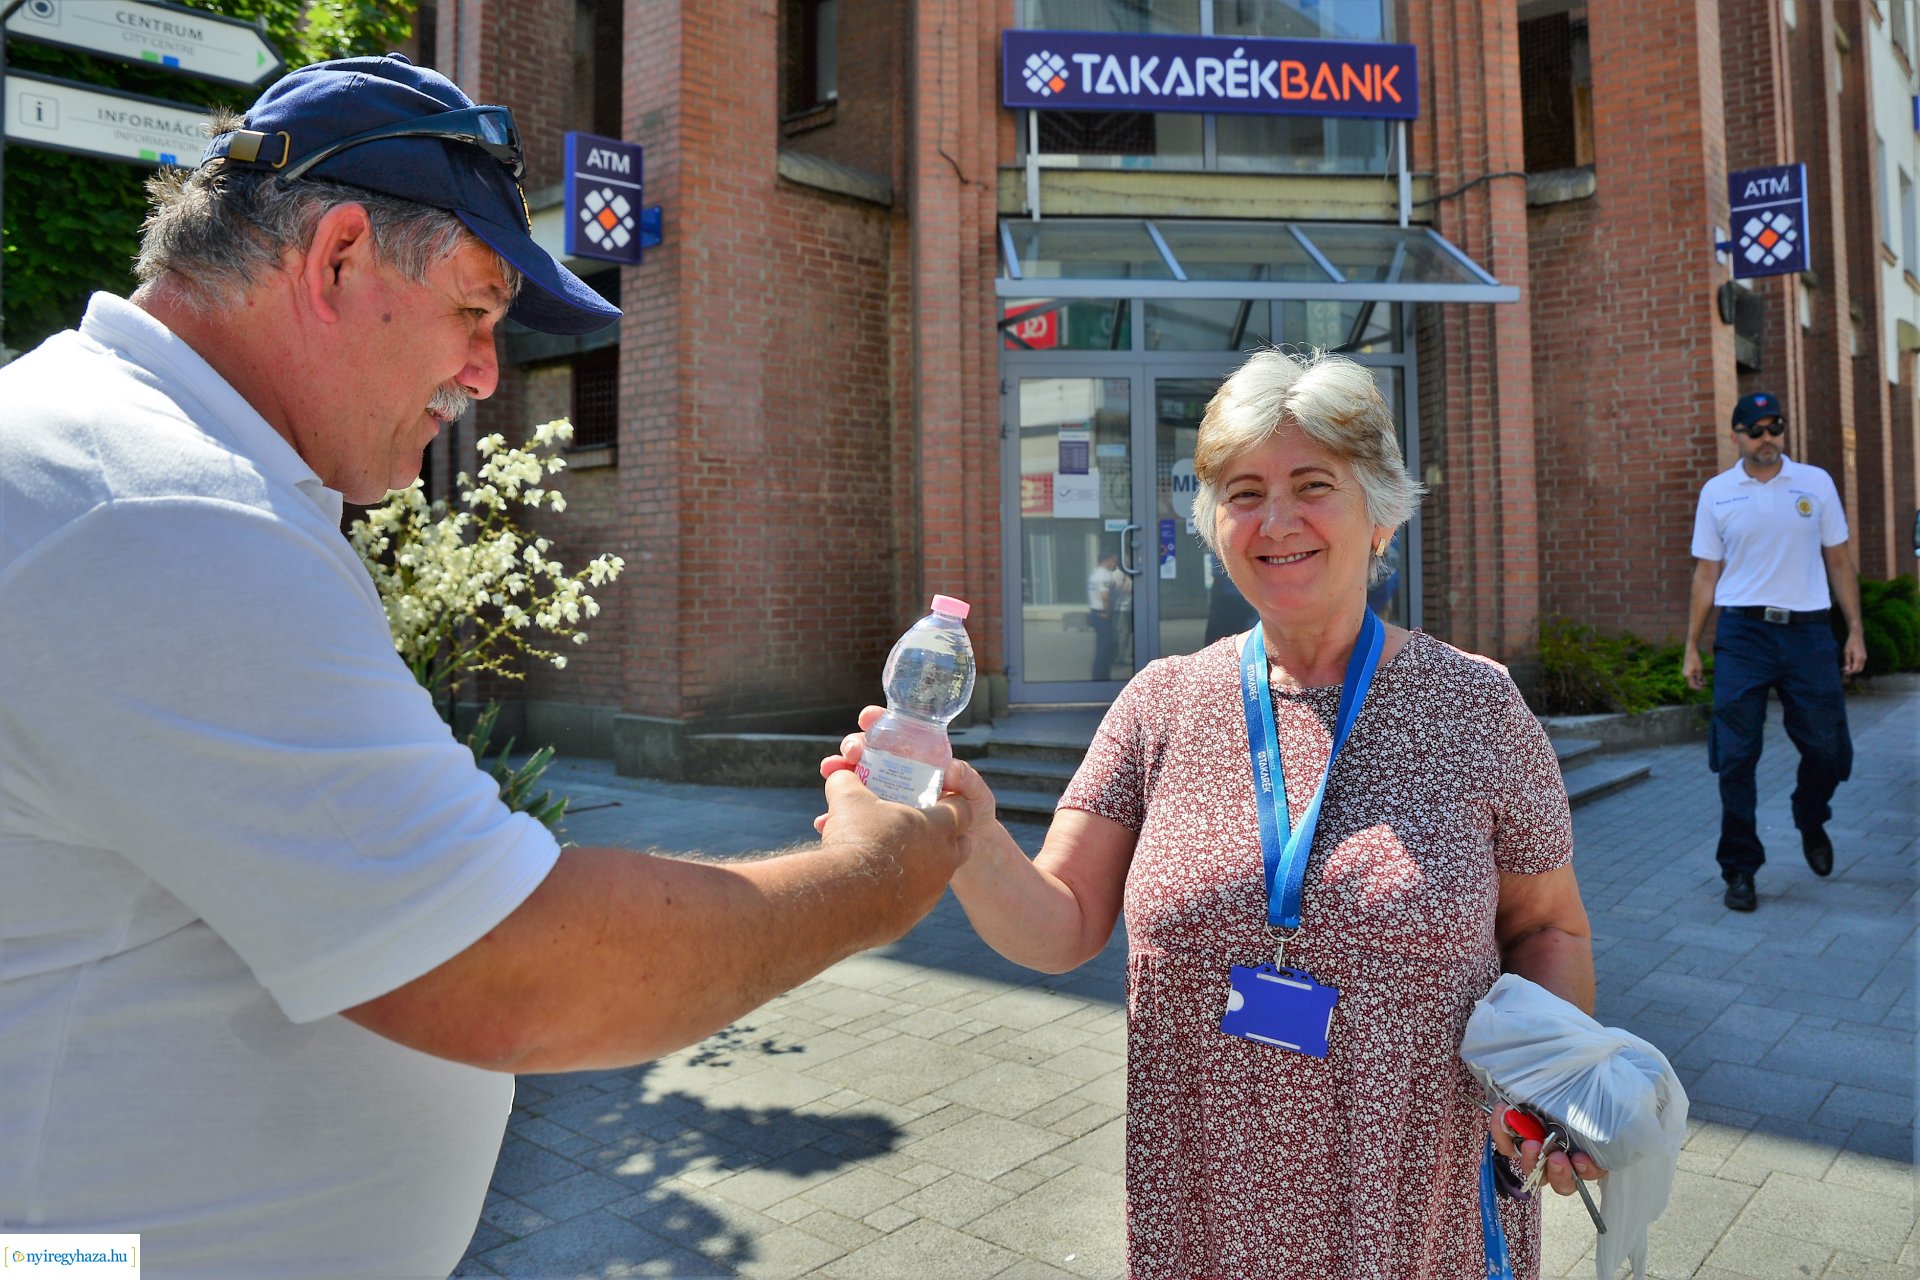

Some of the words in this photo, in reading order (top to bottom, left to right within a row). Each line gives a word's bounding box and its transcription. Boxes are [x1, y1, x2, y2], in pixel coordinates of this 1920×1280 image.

[115, 11, 203, 41] CENTRUM
[121, 31, 148, 43] CITY
[151, 39, 194, 56] CENTRE
[1072, 48, 1401, 103] TAKARÉKBANK
[586, 148, 630, 174] ATM
[1743, 175, 1789, 199] ATM
[1259, 758, 1272, 794] TAKARÉK
